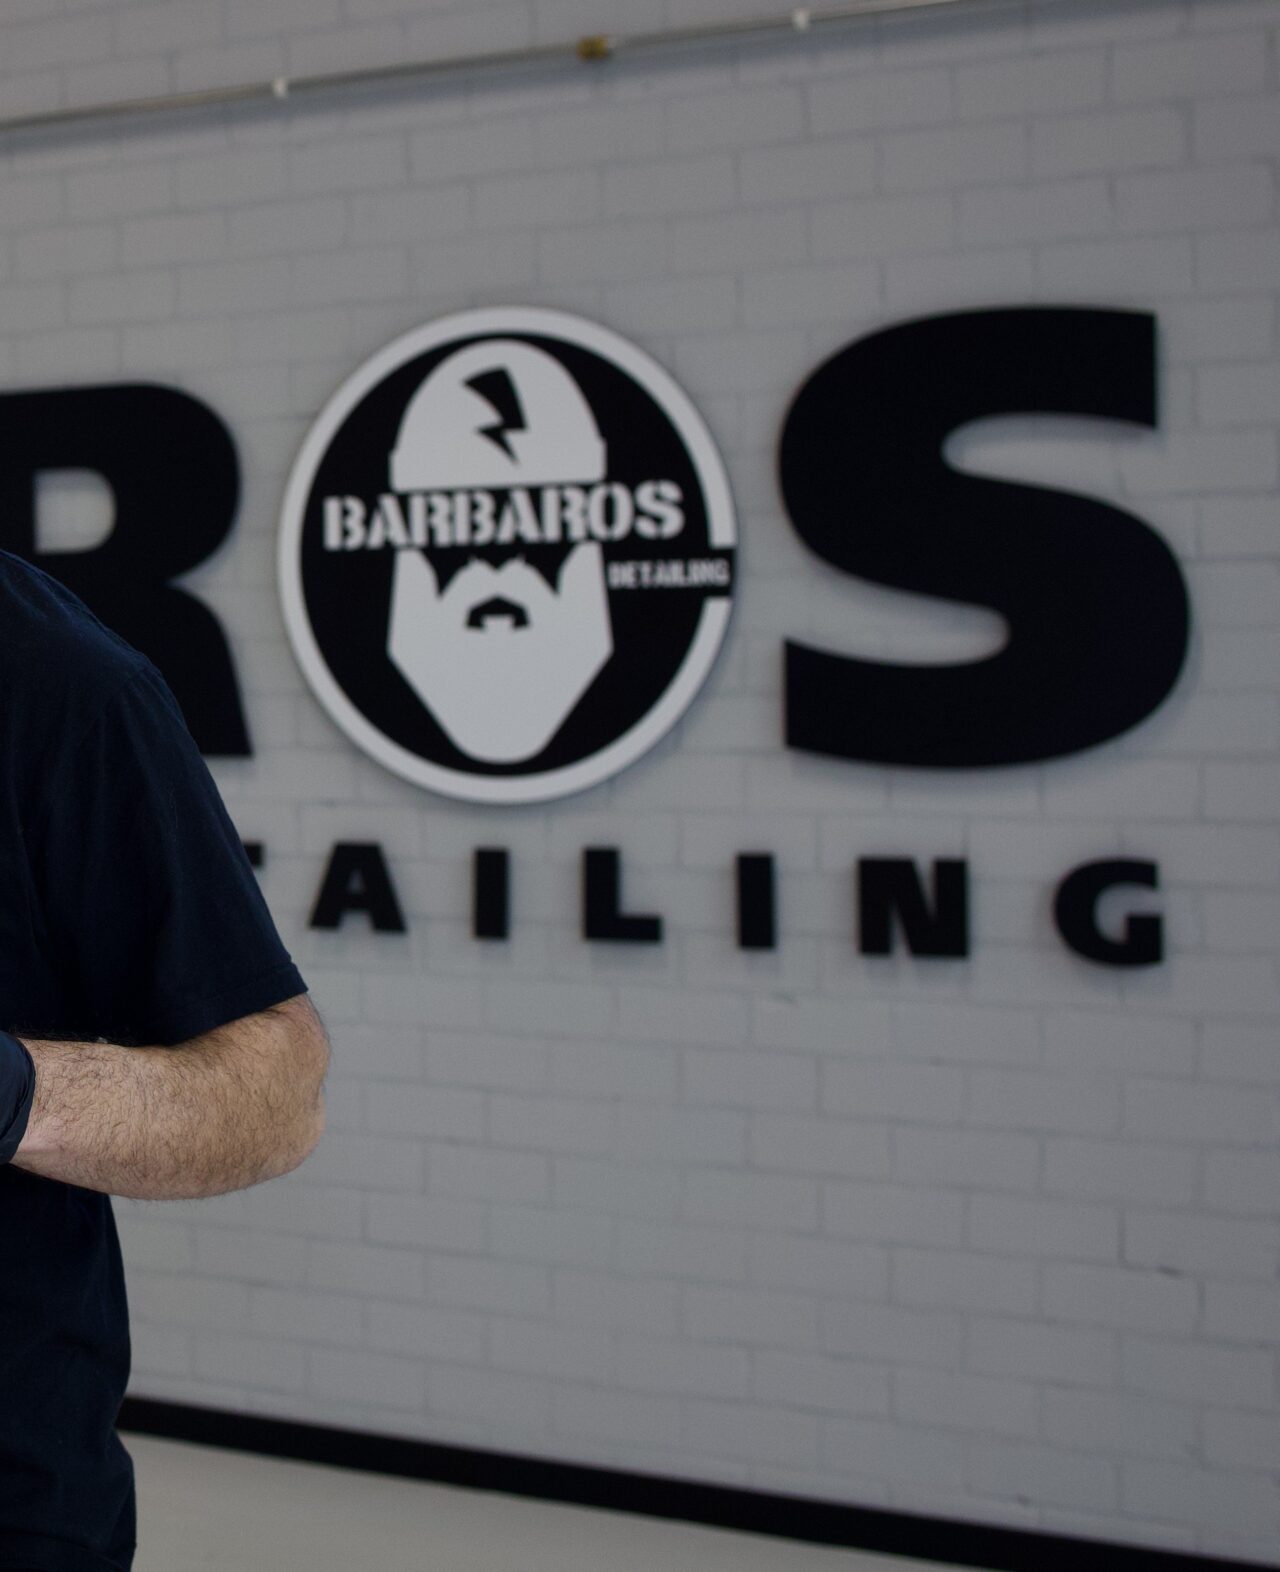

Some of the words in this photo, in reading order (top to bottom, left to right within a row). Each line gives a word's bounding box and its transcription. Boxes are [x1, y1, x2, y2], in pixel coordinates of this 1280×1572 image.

[324, 480, 685, 550] BARBAROS
[607, 558, 730, 591] DETAILING
[243, 841, 1165, 968] AILING
